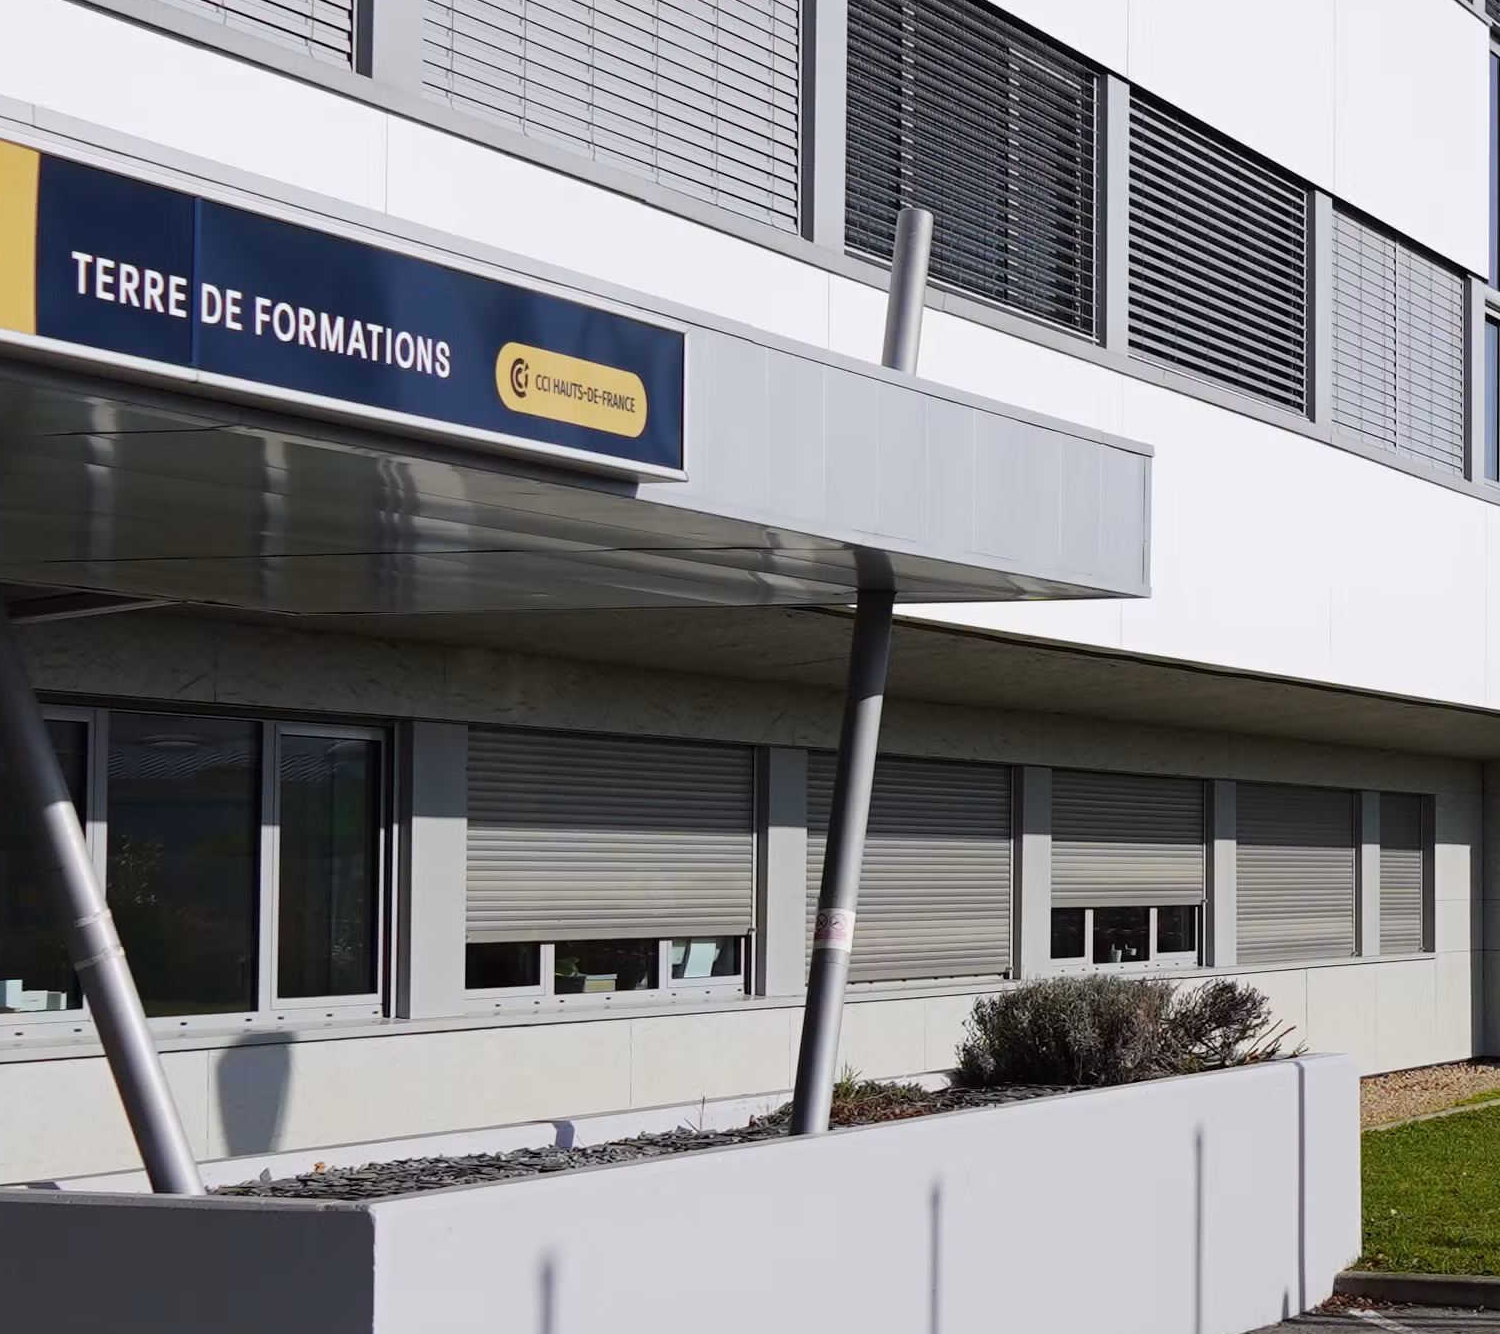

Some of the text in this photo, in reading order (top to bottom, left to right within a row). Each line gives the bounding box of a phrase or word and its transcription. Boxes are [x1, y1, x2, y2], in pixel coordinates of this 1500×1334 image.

[71, 250, 452, 379] TERRE DE FORMATIONS
[535, 373, 636, 413] CCI HAUTS-DE-FRANCE
